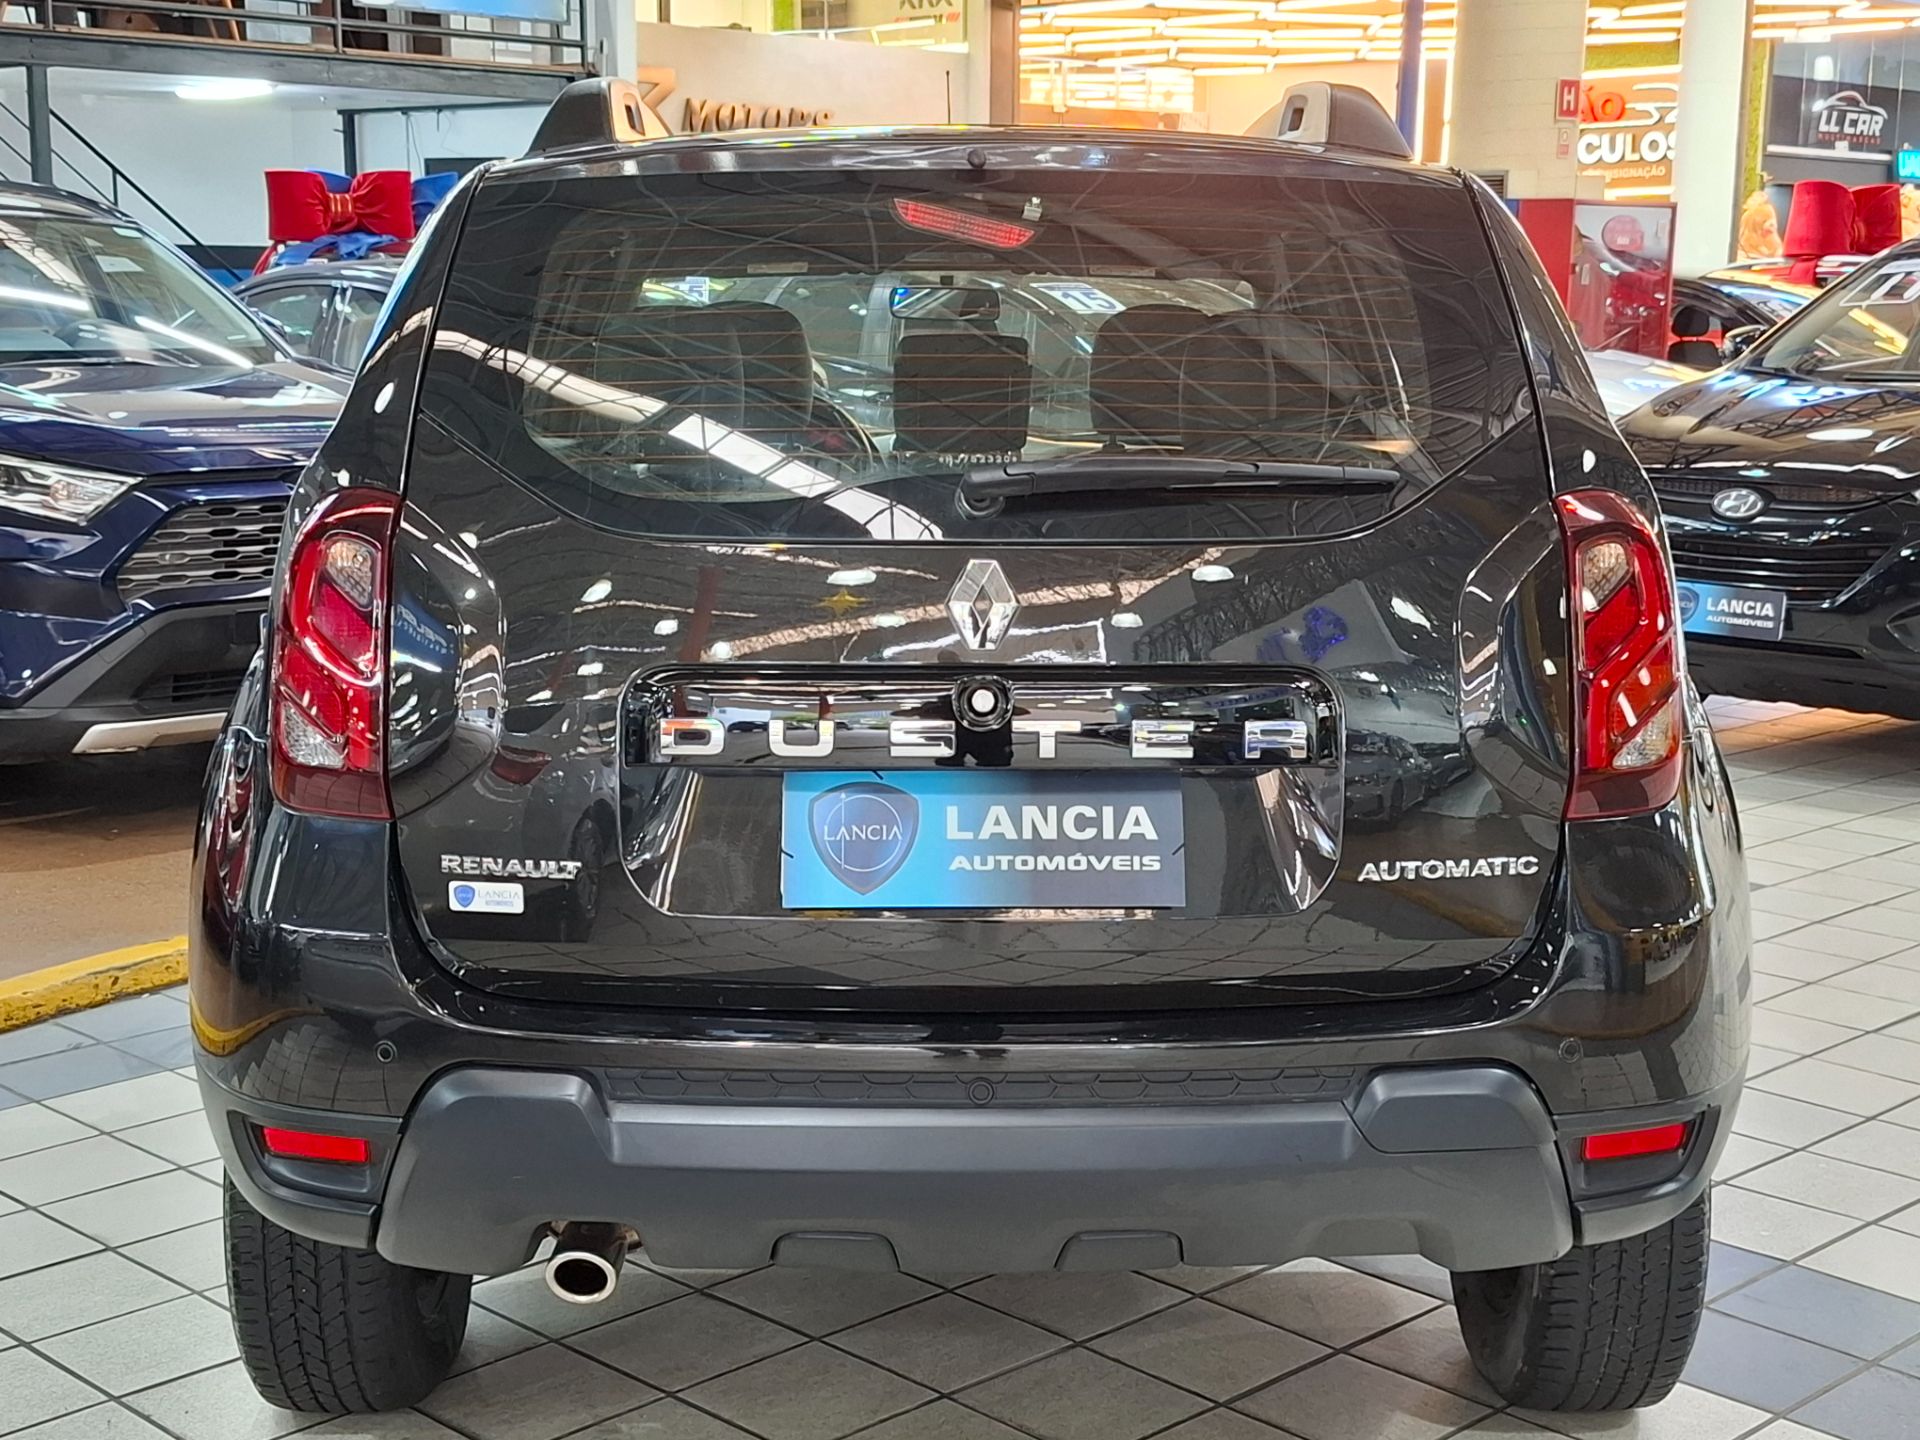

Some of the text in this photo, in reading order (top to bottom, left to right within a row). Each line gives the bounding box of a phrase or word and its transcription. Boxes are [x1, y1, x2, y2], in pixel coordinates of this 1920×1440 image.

[1563, 86, 1575, 111] H
[1818, 110, 1884, 136] LL CAR
[1061, 291, 1117, 310] 15
[1706, 597, 1775, 618] LANCIA
[661, 718, 1309, 760] DUSTER
[824, 825, 903, 841] LANCIA
[946, 805, 1159, 840] LANCIA
[440, 854, 582, 880] RENAULT
[949, 853, 1162, 871] AUTOMÓVEIS
[1357, 856, 1540, 882] AUTOMATIC
